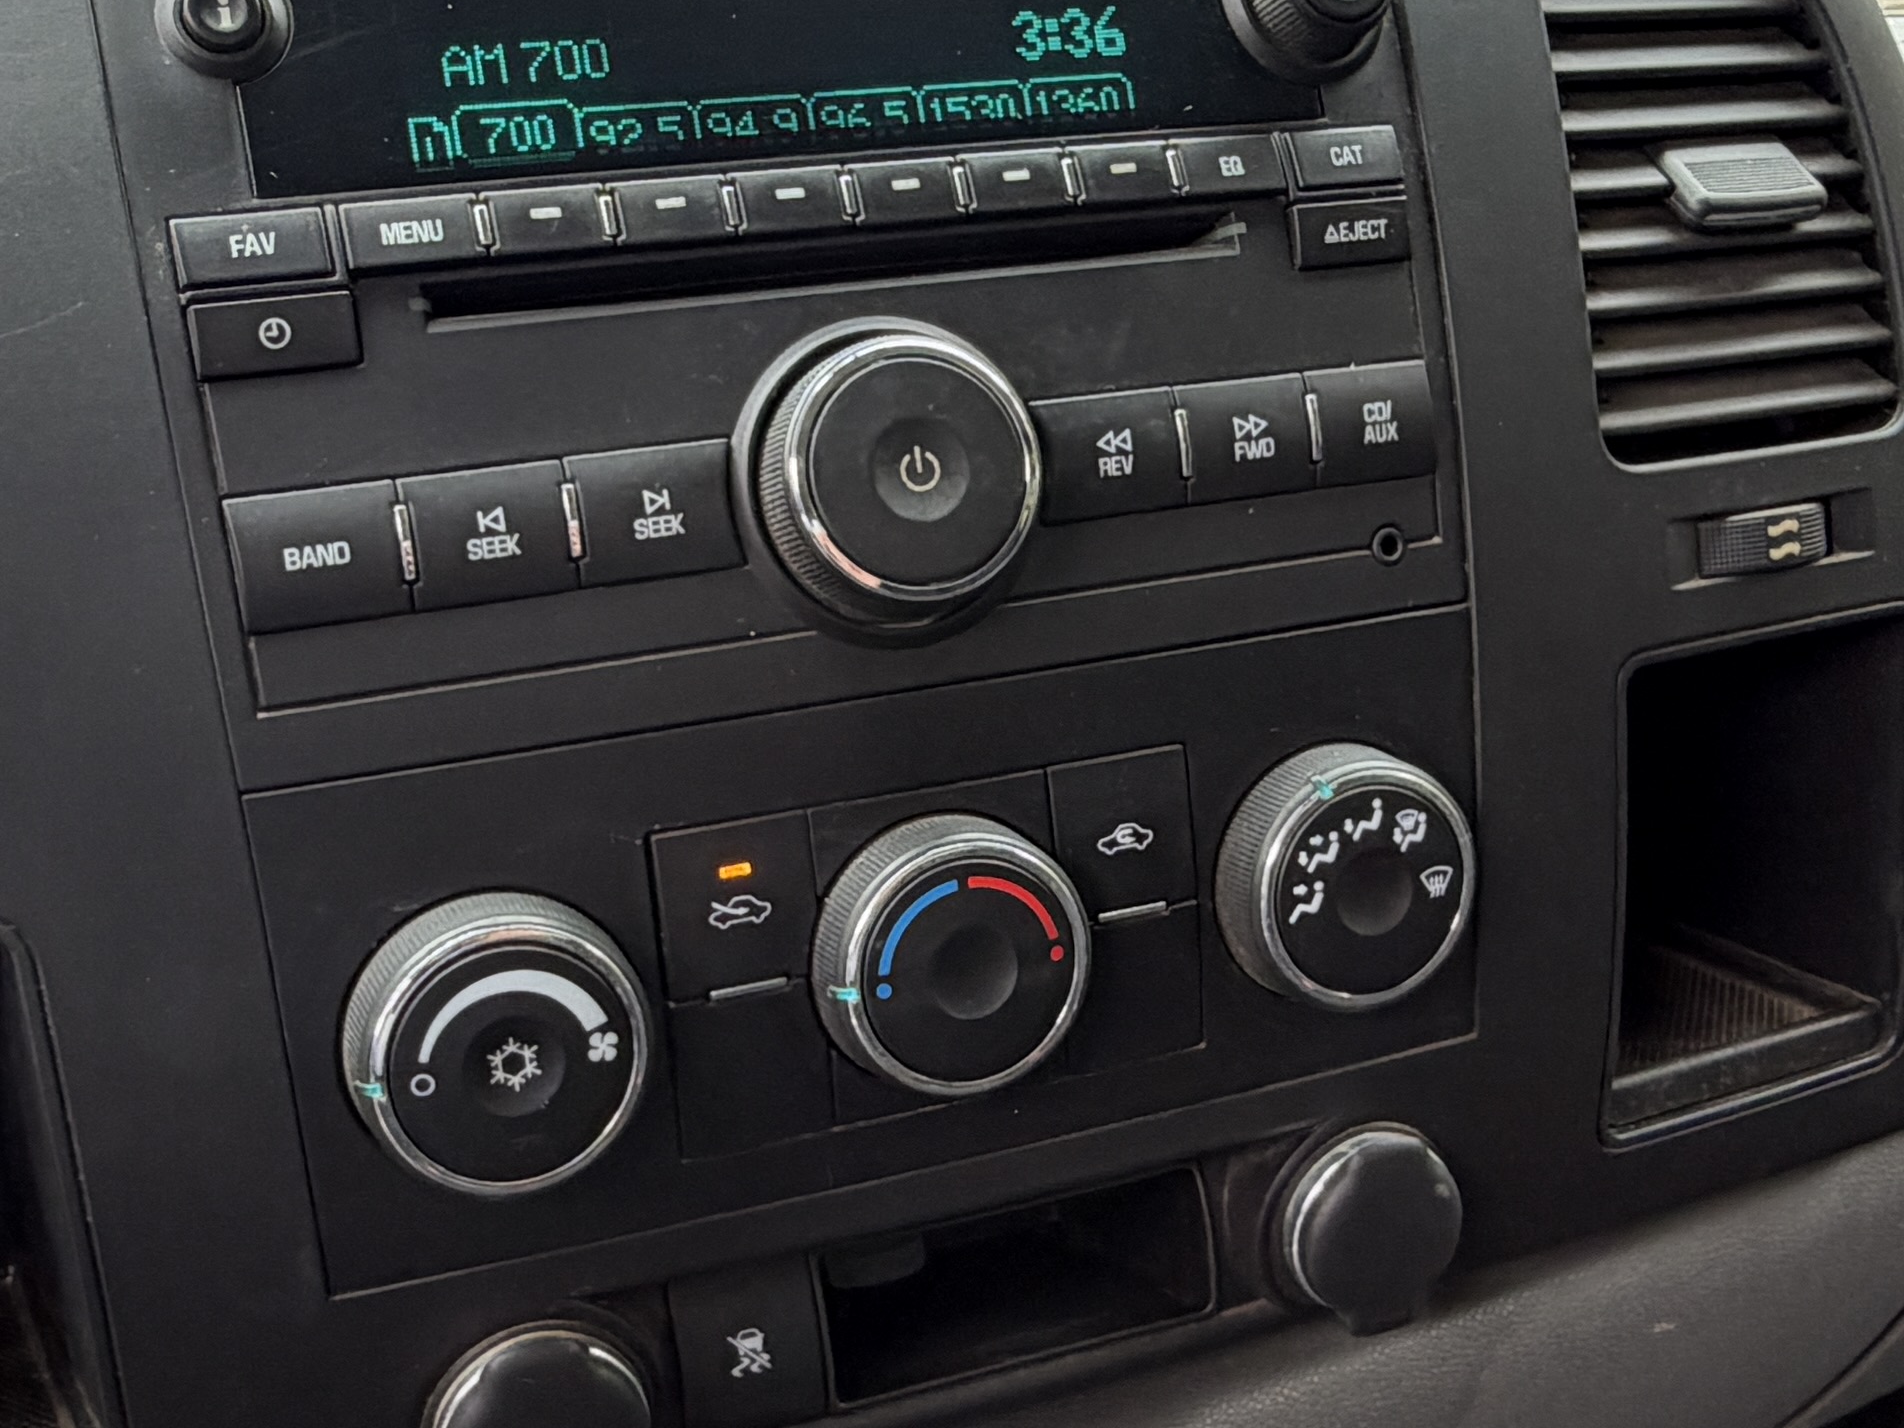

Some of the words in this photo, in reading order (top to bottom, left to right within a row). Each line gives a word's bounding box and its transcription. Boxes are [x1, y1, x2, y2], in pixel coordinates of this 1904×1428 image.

[1011, 5, 1127, 62] 3:36
[441, 43, 509, 87] AM
[519, 38, 610, 83] 700
[479, 114, 557, 154] 700
[1218, 155, 1246, 177] EQ
[1329, 144, 1364, 167] CAT
[379, 218, 445, 246] MENU
[1338, 218, 1389, 243] EJECT
[228, 231, 276, 258] FAV
[1362, 399, 1393, 424] CD/
[1363, 421, 1399, 445] AUX
[1233, 437, 1276, 462] FWD
[1097, 454, 1134, 479] REV
[632, 512, 686, 541] SEEK
[282, 540, 352, 572] BAND
[466, 532, 522, 561] SEEK
